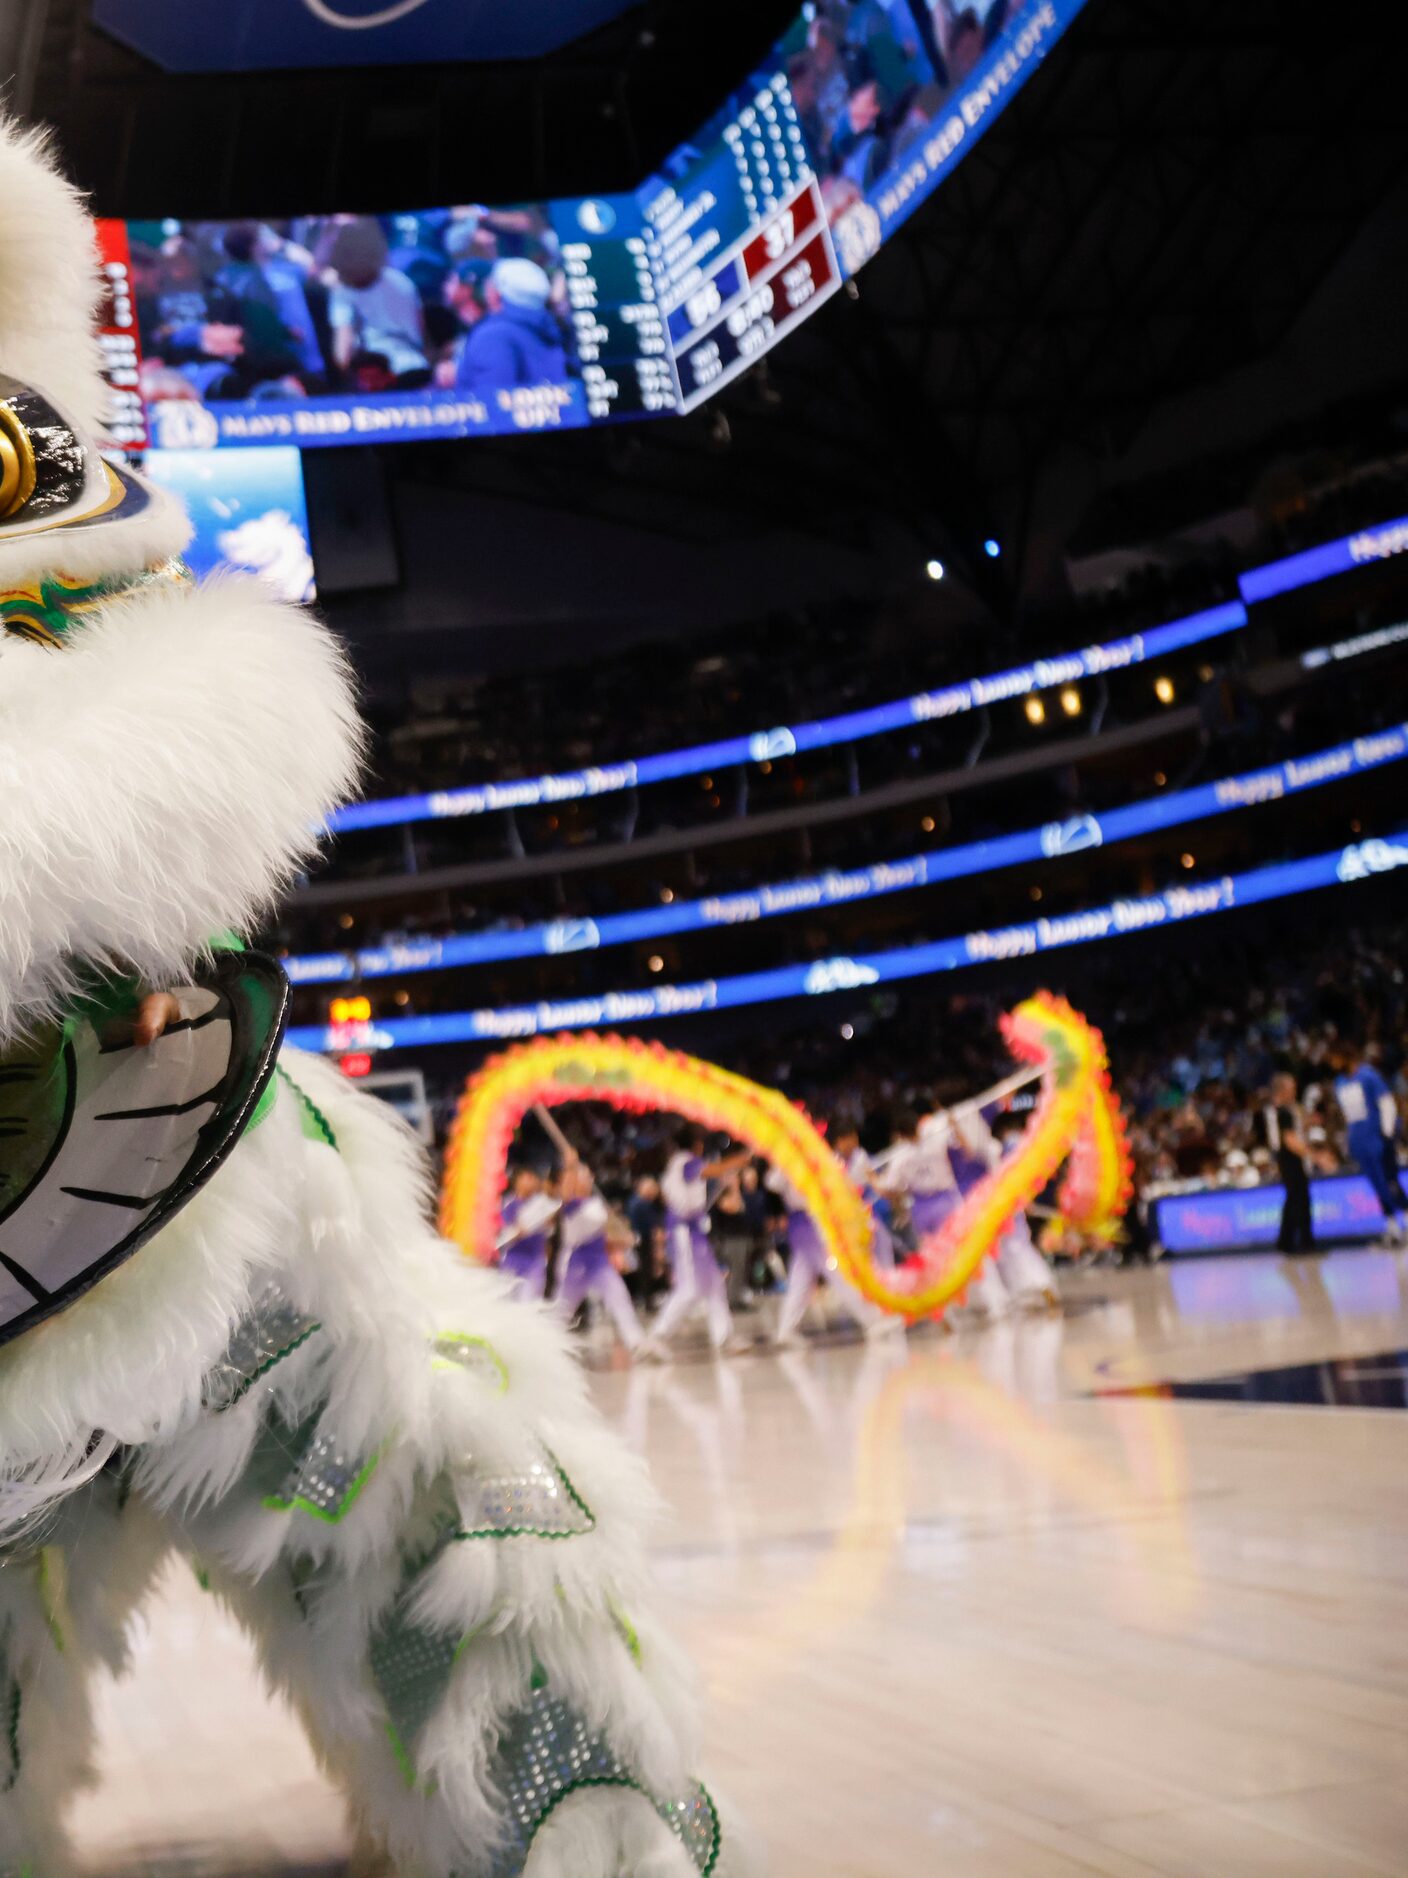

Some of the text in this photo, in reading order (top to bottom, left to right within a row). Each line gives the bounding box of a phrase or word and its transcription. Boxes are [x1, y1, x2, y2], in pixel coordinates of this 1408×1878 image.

[923, 115, 965, 171] RED
[960, 3, 1057, 127] ENVELOPE
[222, 402, 488, 436] MAVS RED ENVELOPE
[497, 385, 571, 410] LOOK
[912, 693, 971, 721] Happy
[971, 678, 1032, 705] Lunar
[1033, 660, 1083, 688] New
[430, 793, 485, 817] Happy
[485, 784, 540, 810] Lunar
[540, 775, 585, 802] New
[1216, 738, 1405, 806] Happy Lunar New
[702, 898, 760, 924] Happy
[760, 886, 822, 912] Lunar
[823, 871, 871, 899] New
[965, 931, 1036, 960] Happy
[1036, 918, 1111, 947] Lunar
[1111, 901, 1166, 932] New
[473, 1010, 537, 1037] Happy
[537, 1001, 604, 1030] Lunar
[603, 993, 656, 1020] New
